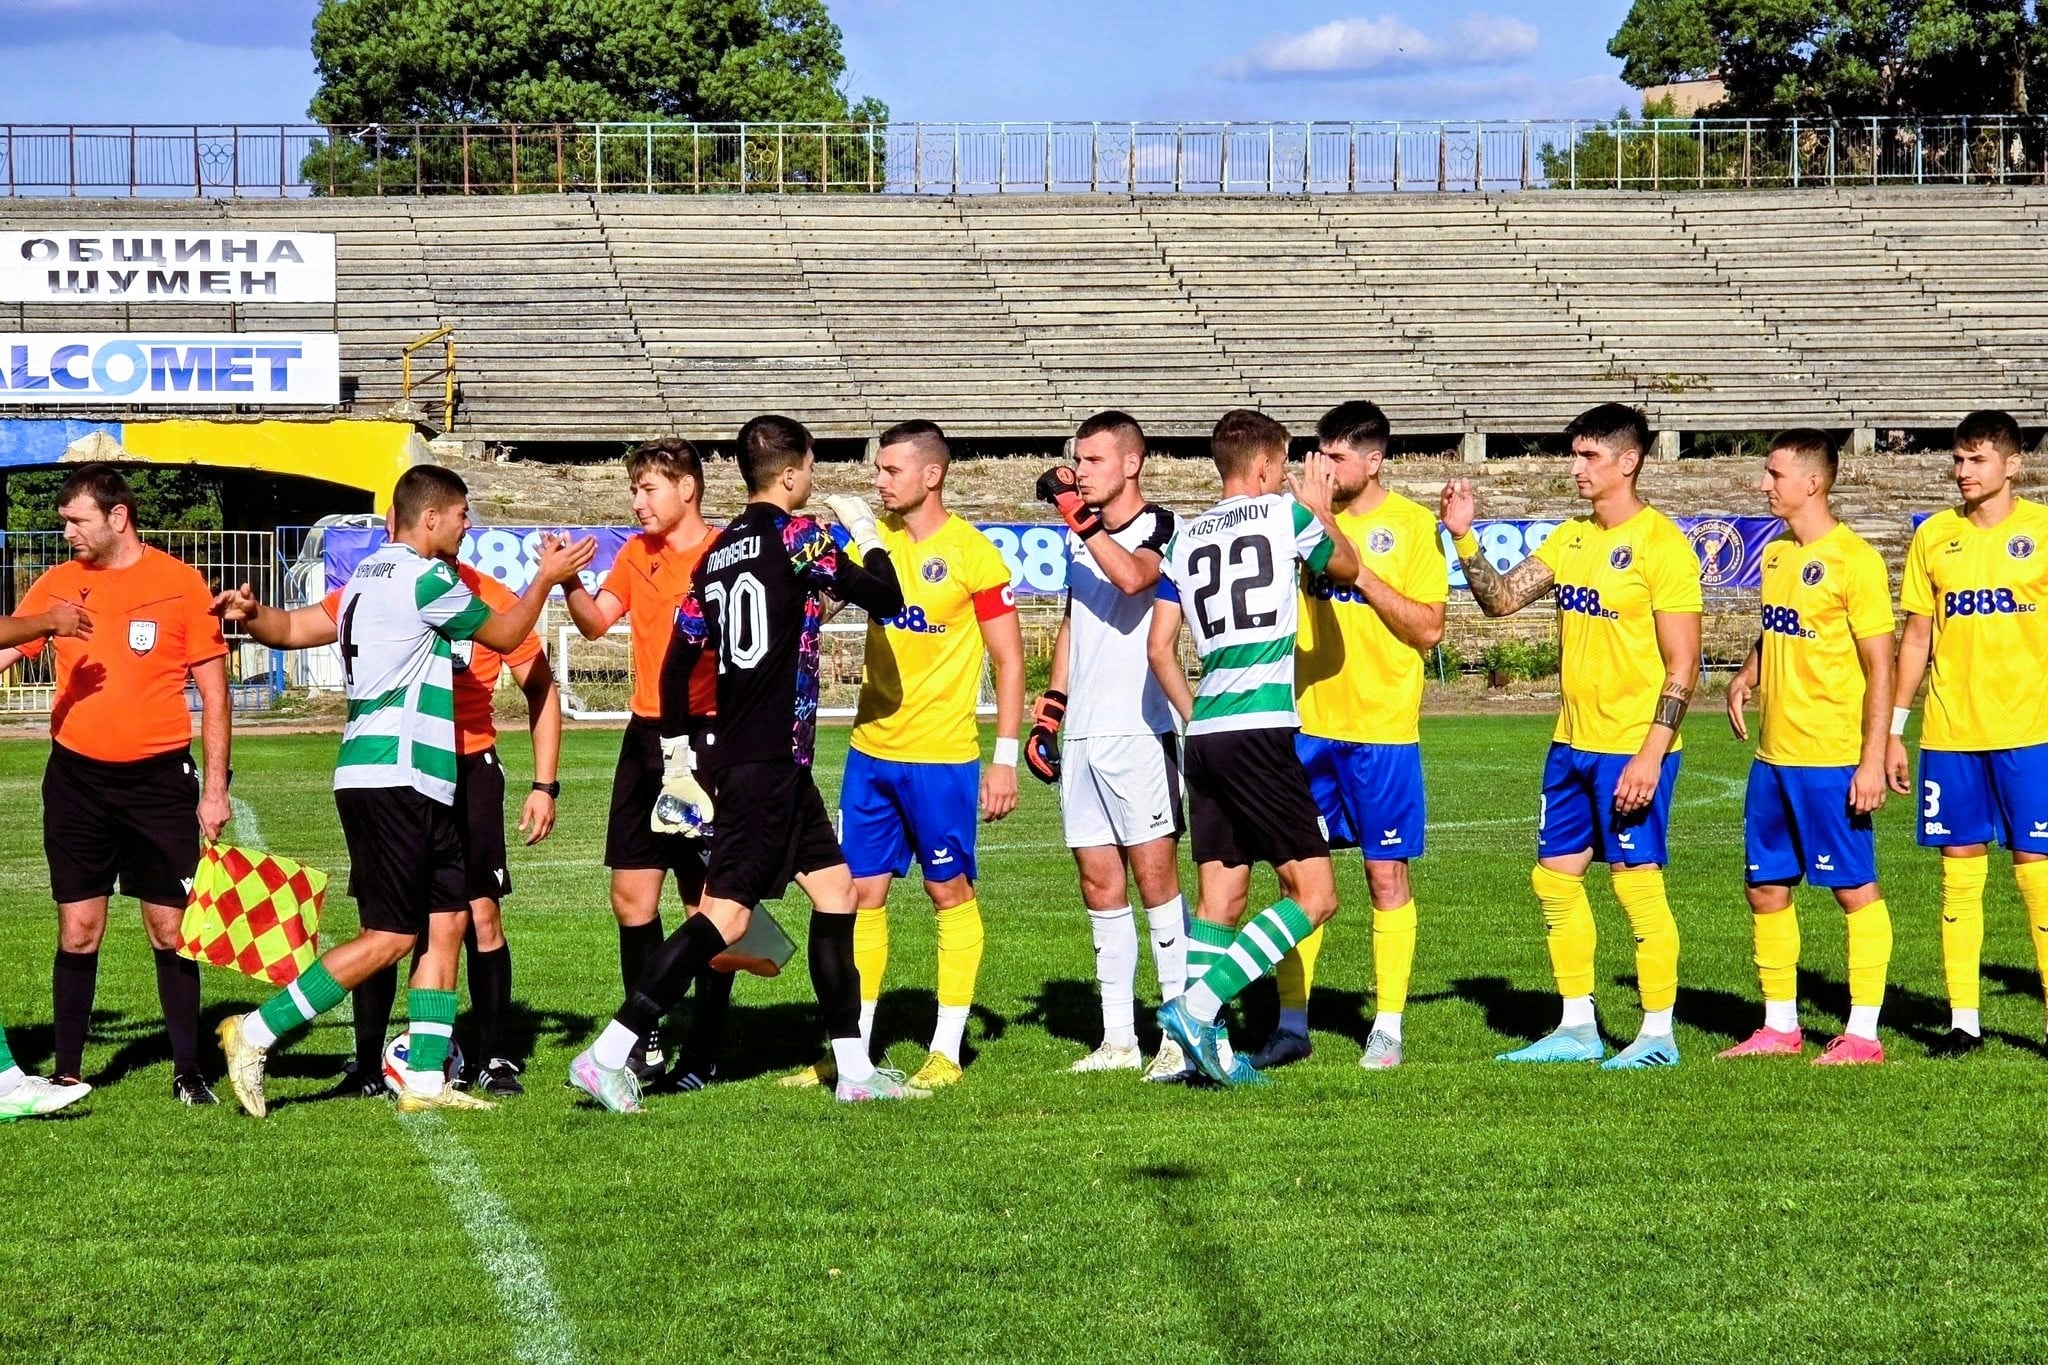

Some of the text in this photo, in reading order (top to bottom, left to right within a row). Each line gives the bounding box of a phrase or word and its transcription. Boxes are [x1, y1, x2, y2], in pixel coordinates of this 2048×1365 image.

[20, 238, 304, 267] ОБЩИНА
[48, 270, 277, 294] ШУМЕН
[0, 340, 302, 395] LCOMET
[1188, 504, 1269, 538] KOSTADINOV
[1188, 534, 1277, 640] 22
